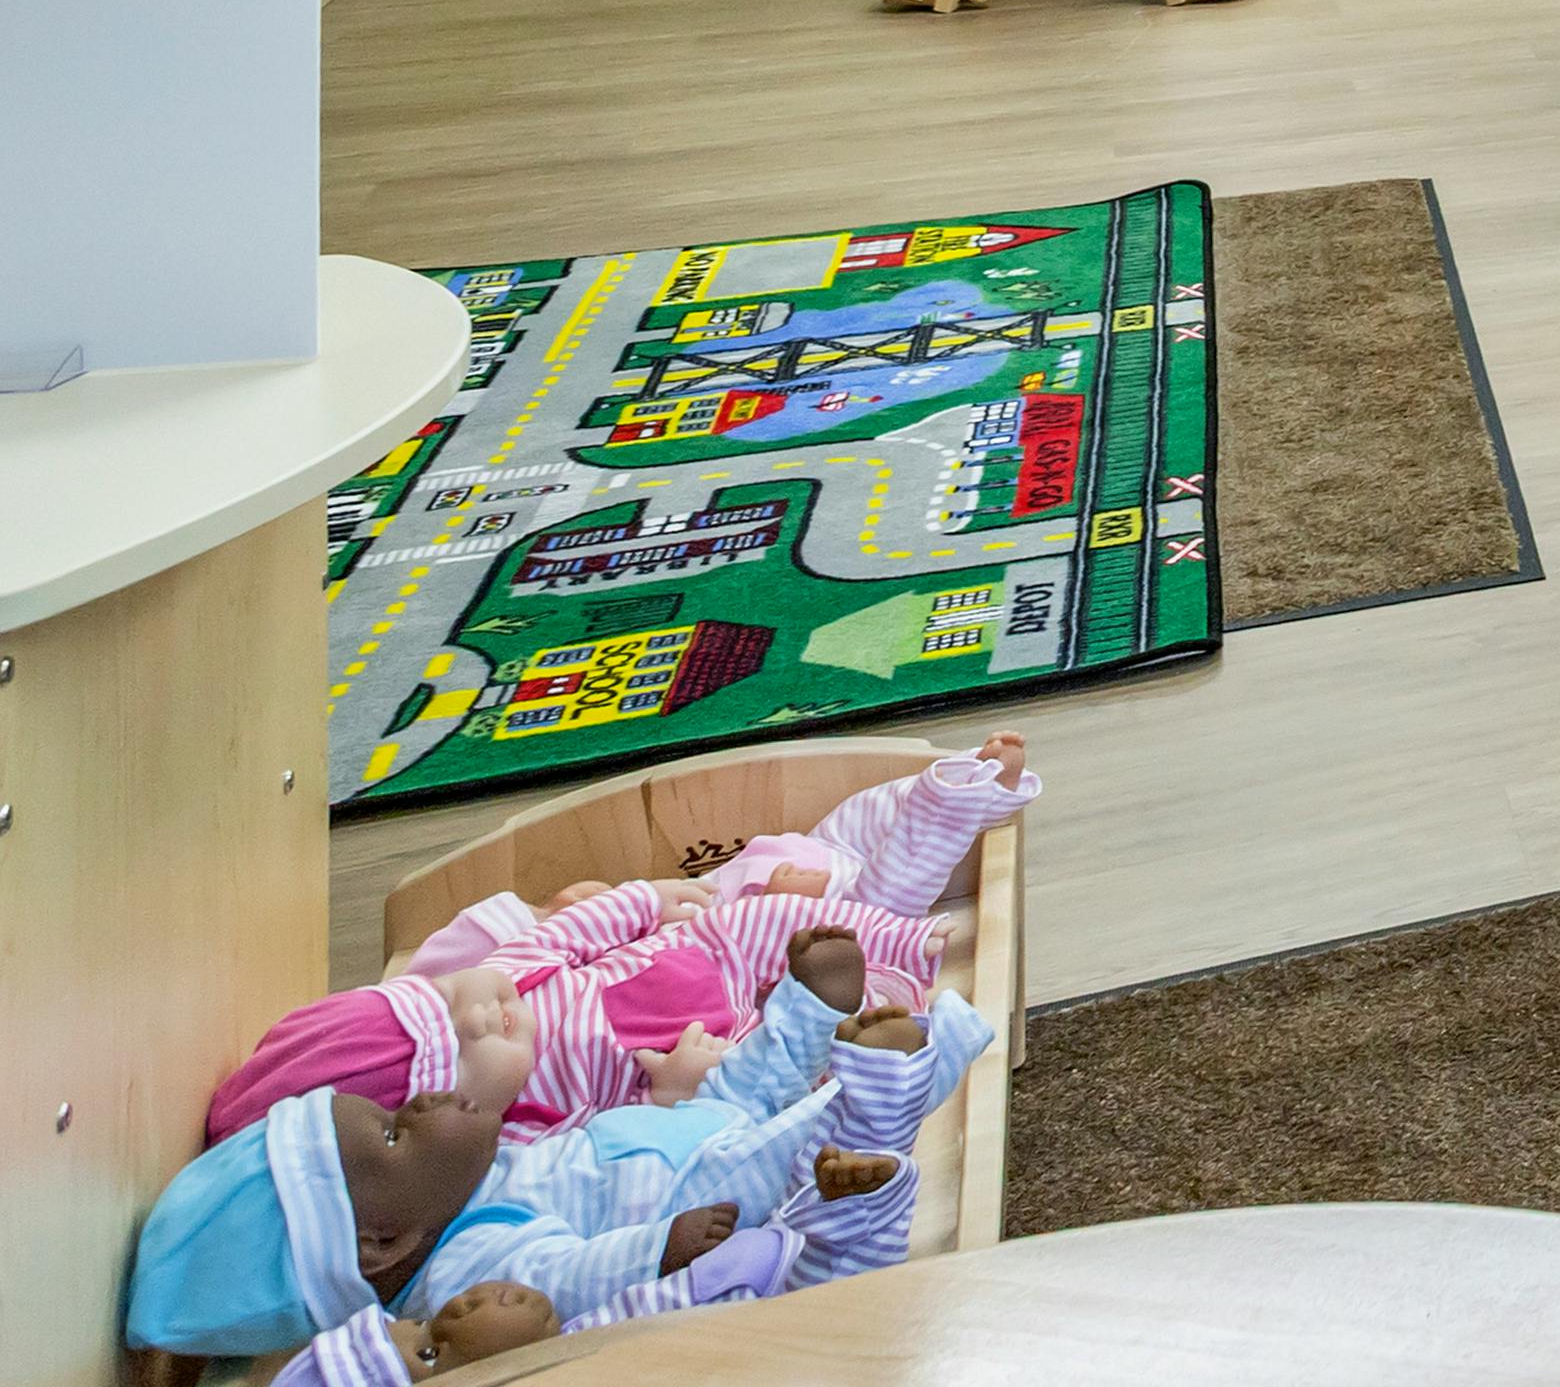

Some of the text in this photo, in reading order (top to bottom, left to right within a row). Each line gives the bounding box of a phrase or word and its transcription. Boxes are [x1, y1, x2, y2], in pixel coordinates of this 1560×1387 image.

[684, 250, 719, 267] NO
[537, 551, 739, 592] LIBRARY
[1005, 581, 1056, 637] DEPOT
[568, 640, 643, 721] SCHOOL
